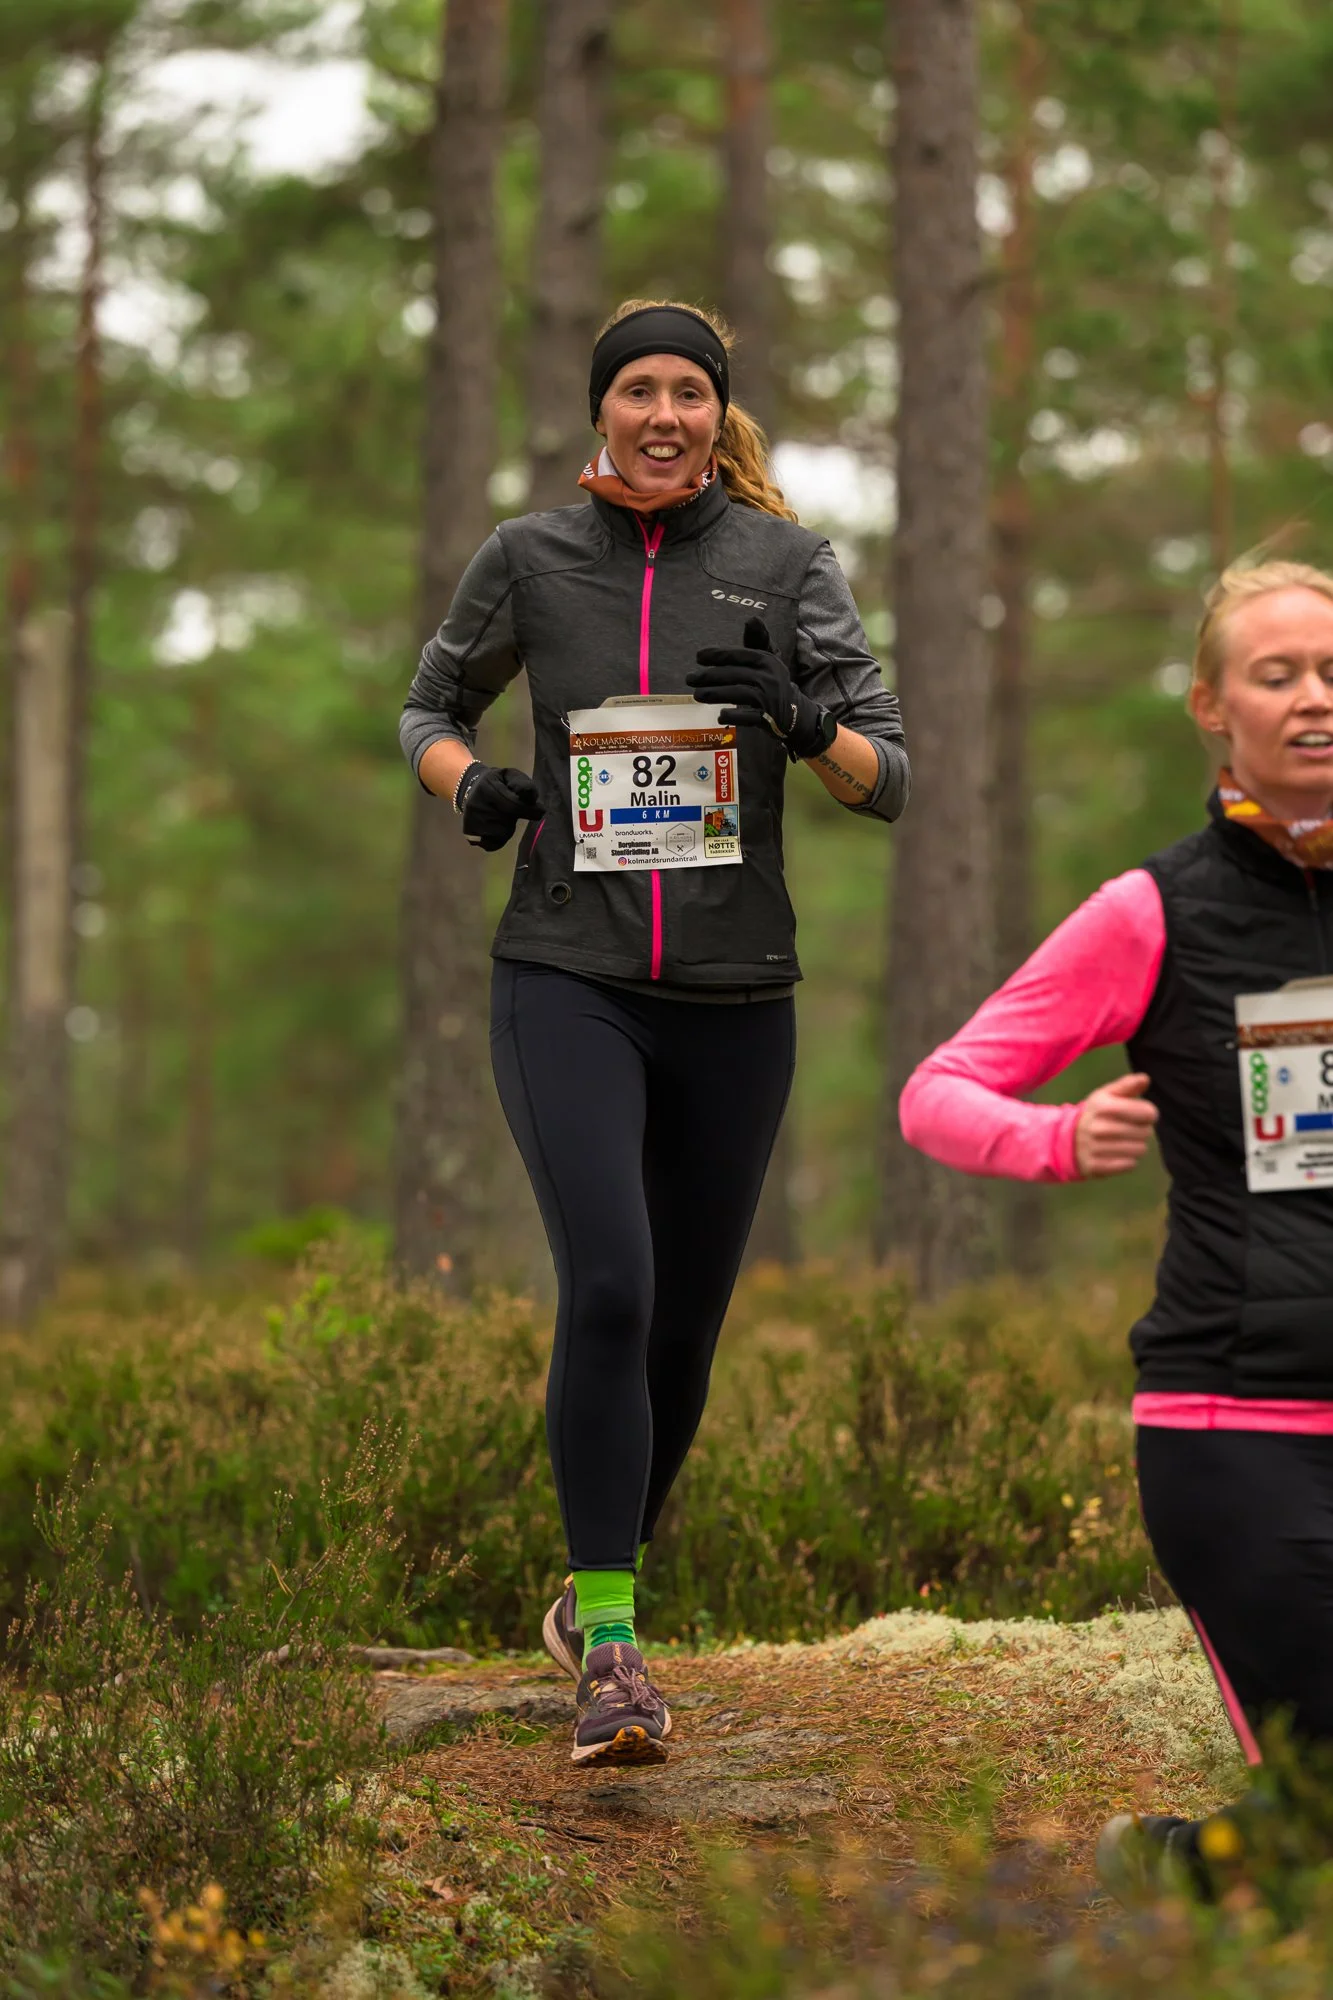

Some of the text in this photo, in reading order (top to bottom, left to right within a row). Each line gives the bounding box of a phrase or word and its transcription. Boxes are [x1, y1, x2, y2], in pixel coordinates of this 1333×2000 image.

[726, 594, 768, 610] SOC
[632, 754, 677, 788] 82
[577, 756, 593, 809] coop
[720, 768, 728, 799] CIRCLE
[630, 790, 681, 807] Malin
[642, 810, 648, 819] 6
[708, 842, 736, 850] NØTTE
[627, 855, 698, 865] kolmardsrundantrail
